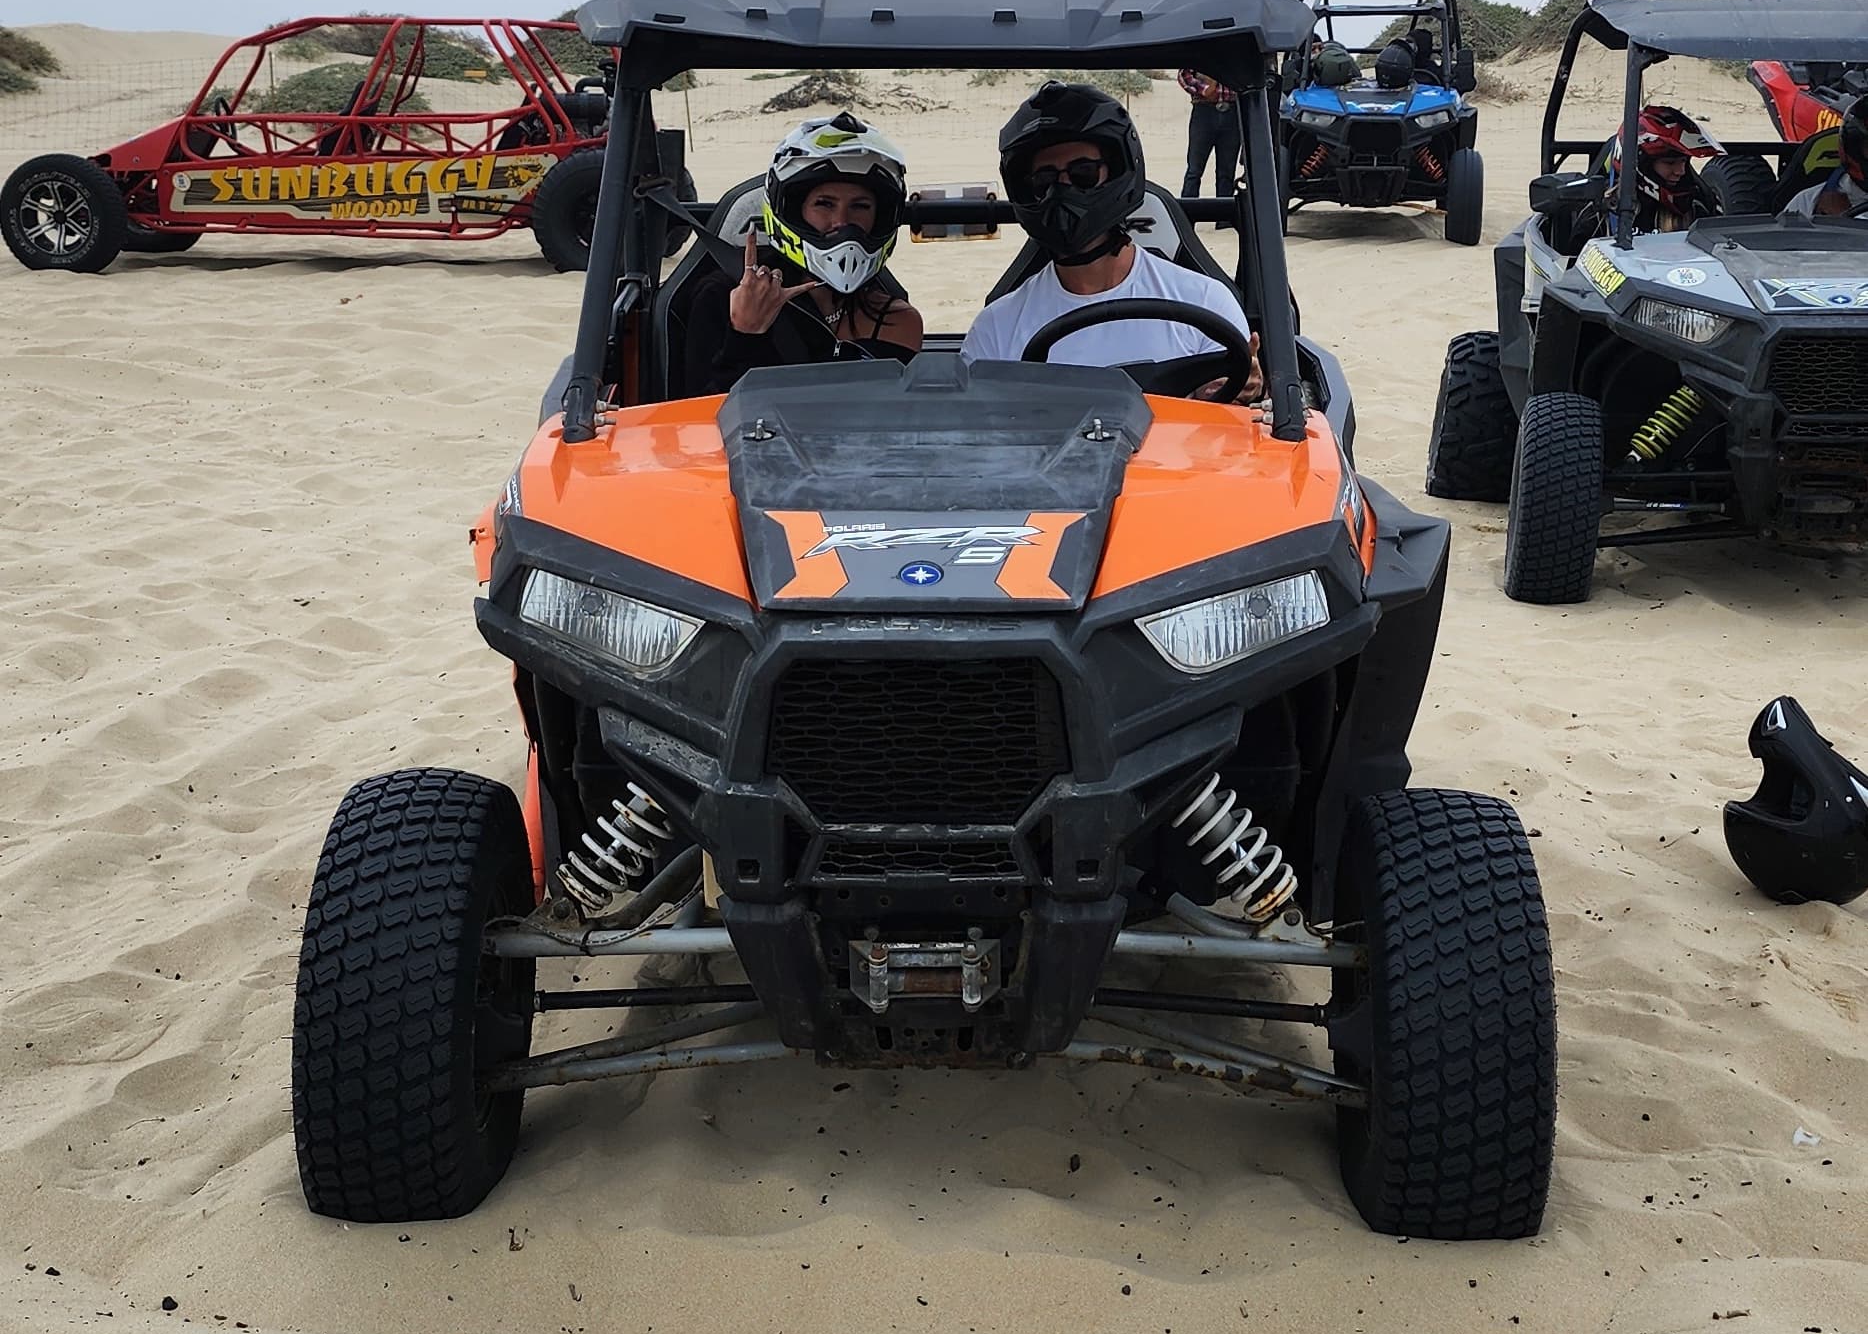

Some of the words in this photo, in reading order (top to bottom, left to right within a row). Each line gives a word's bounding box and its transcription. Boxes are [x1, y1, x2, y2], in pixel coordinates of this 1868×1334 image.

[210, 154, 496, 201] SUNBUGGY
[330, 199, 418, 219] WOODY
[823, 523, 886, 533] POLARIS
[797, 526, 1045, 560] RZR
[953, 546, 1008, 565] S
